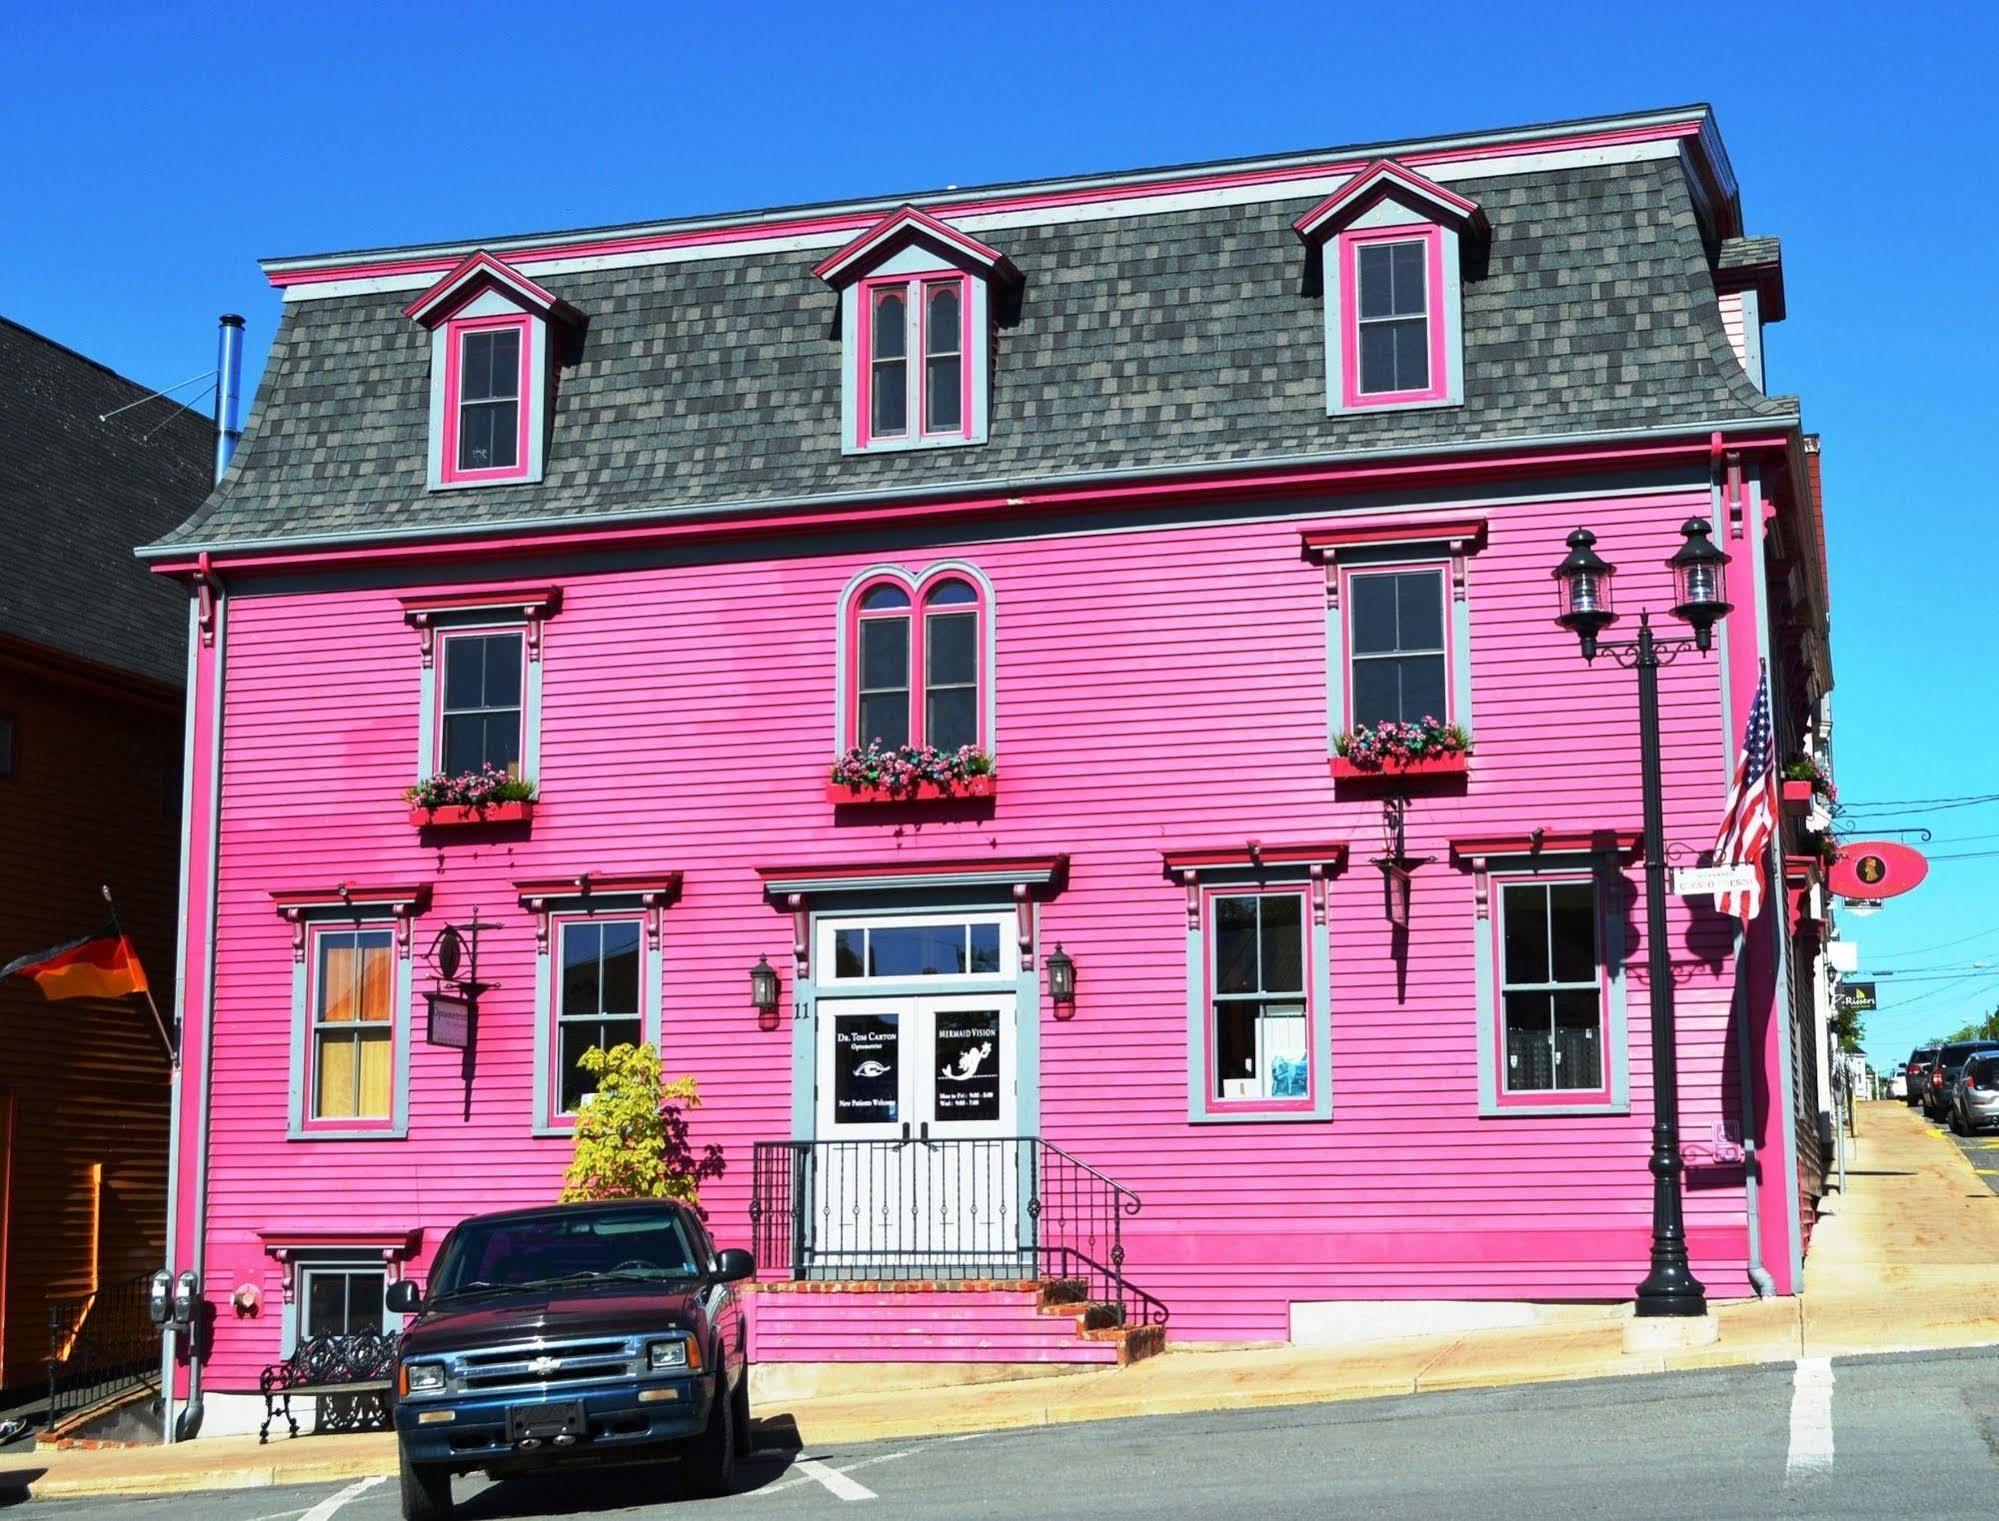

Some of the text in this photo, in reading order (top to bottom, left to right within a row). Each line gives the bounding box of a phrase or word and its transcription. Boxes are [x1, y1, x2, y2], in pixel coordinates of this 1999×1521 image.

[794, 1002, 810, 1020] 11
[938, 1027, 996, 1038] MERMAID VISION
